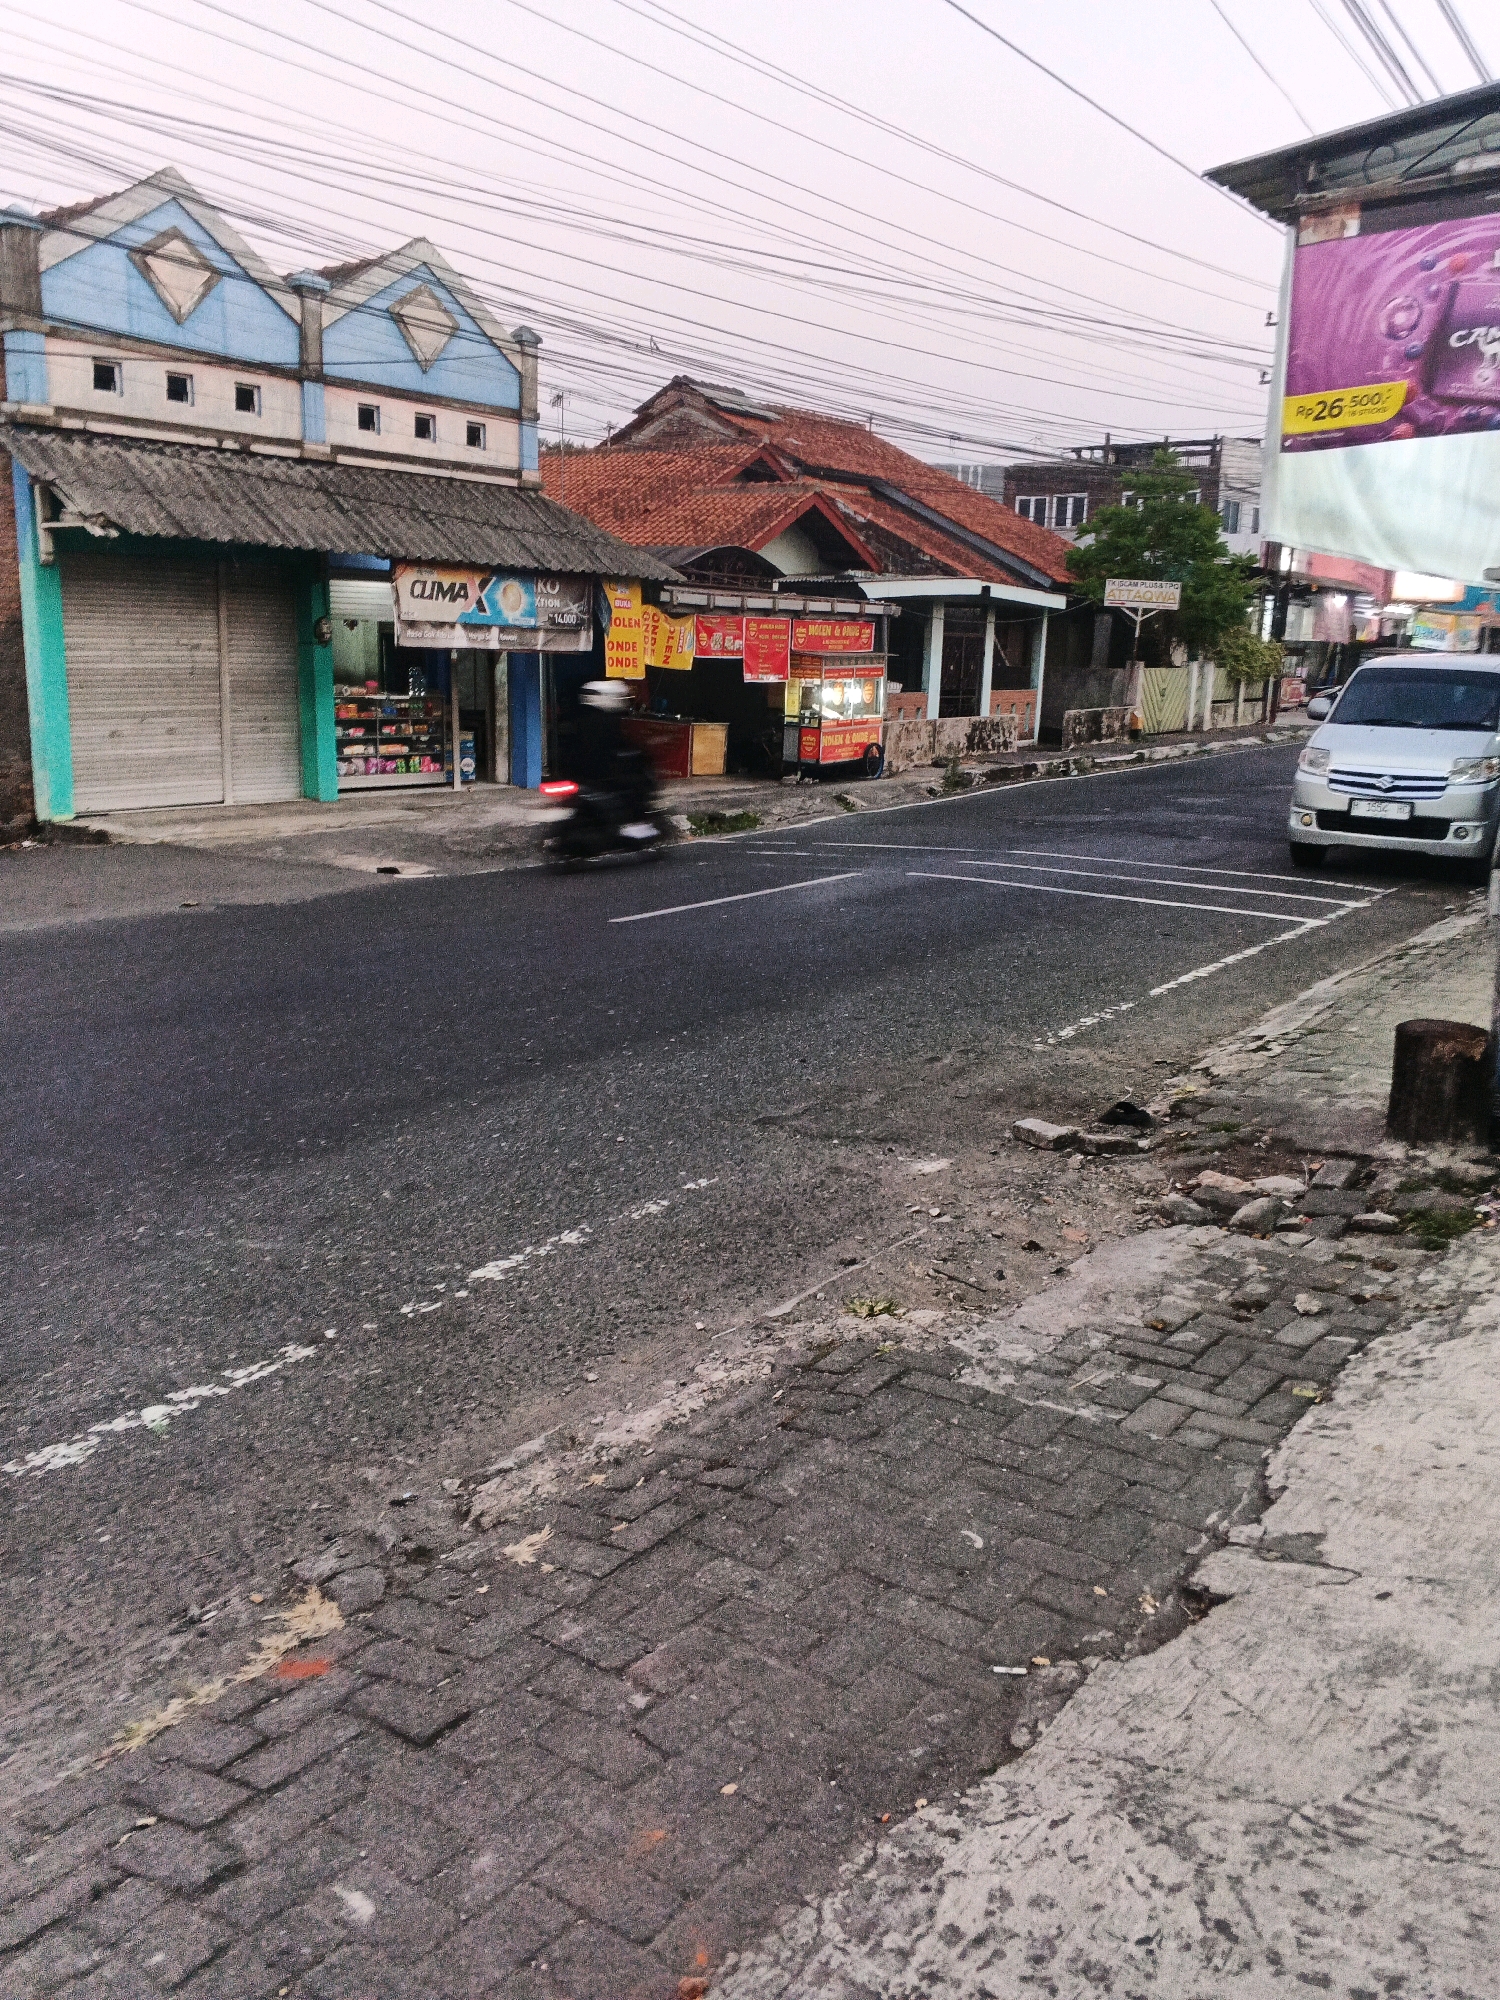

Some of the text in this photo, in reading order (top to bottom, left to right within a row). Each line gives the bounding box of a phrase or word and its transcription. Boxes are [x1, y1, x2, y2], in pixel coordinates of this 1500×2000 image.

[409, 576, 497, 616] CLIMAX
[614, 599, 632, 608] BUKA
[607, 640, 638, 652] ONDE
[607, 657, 638, 668] ONDE
